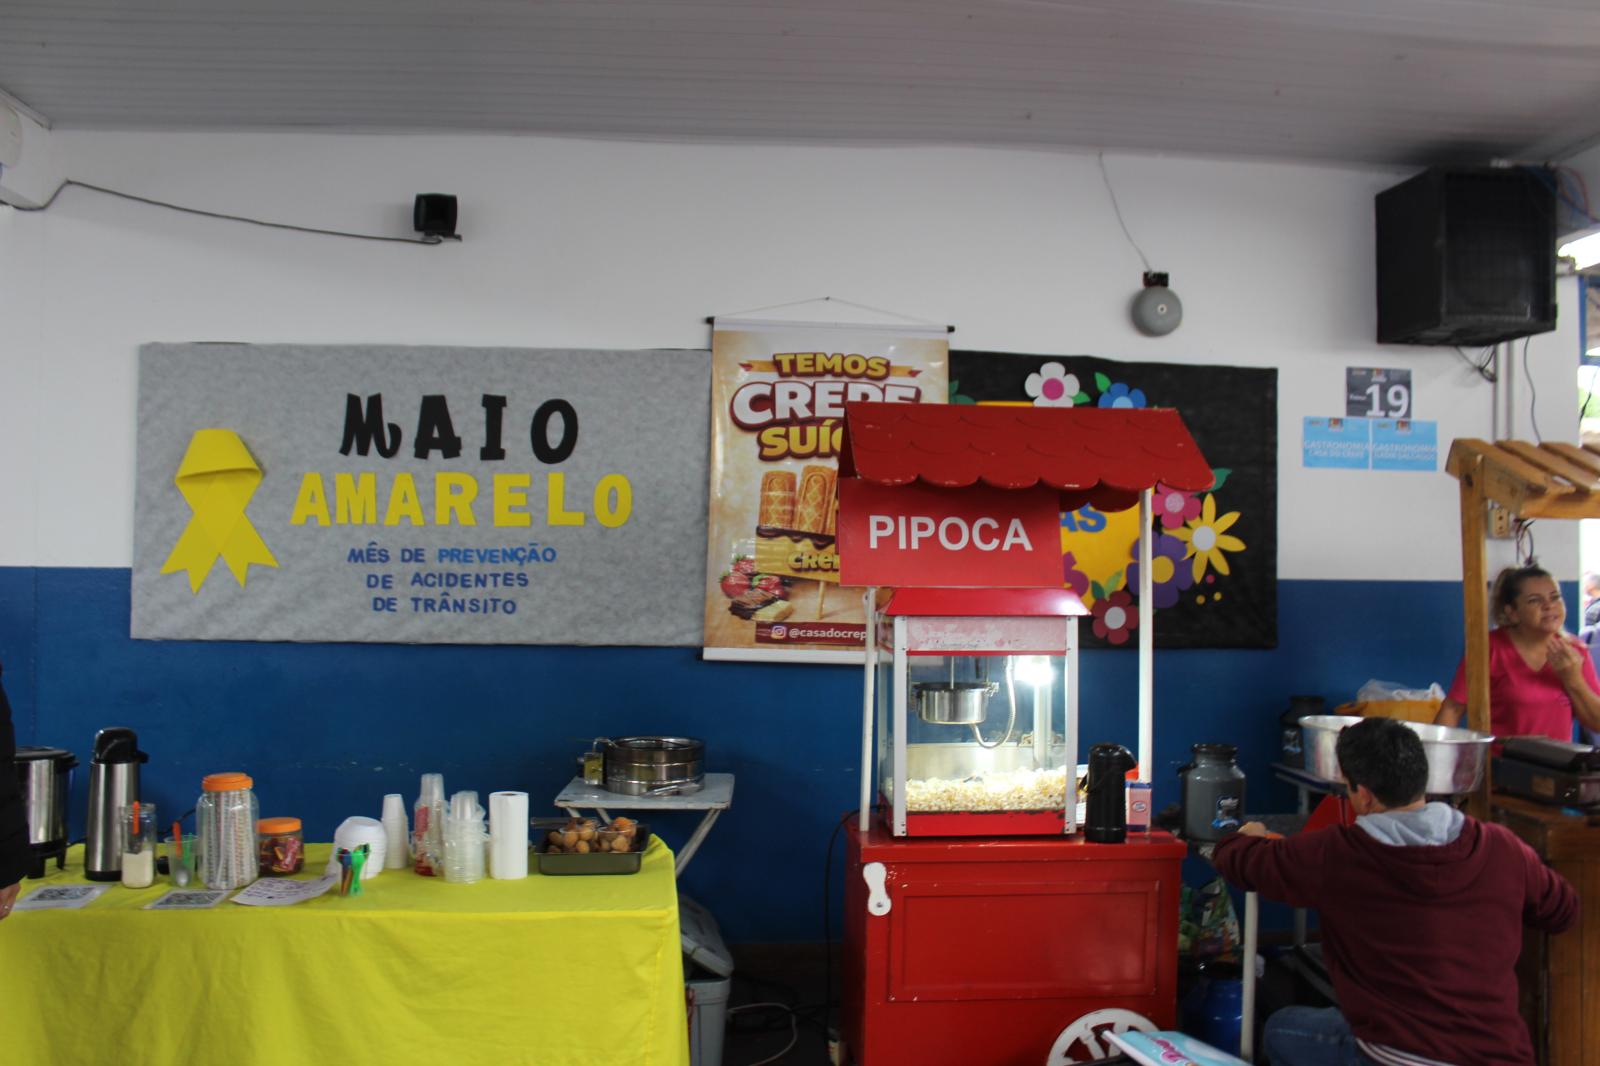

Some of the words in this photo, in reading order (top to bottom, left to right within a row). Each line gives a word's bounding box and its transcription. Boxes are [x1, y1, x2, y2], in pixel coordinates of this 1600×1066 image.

[773, 352, 890, 379] TEMOS
[1365, 383, 1409, 418] 19
[339, 393, 578, 464] MAIO
[290, 472, 632, 528] AMARELO
[869, 515, 1033, 551] PIPOCA
[348, 541, 389, 563] MÊS
[401, 548, 425, 563] DE
[438, 543, 556, 566] PREVENÇÃO
[366, 574, 393, 589] DE
[411, 572, 528, 588] ACIDENTES
[373, 597, 397, 612] DE
[411, 592, 516, 614] TRÂNSITO
